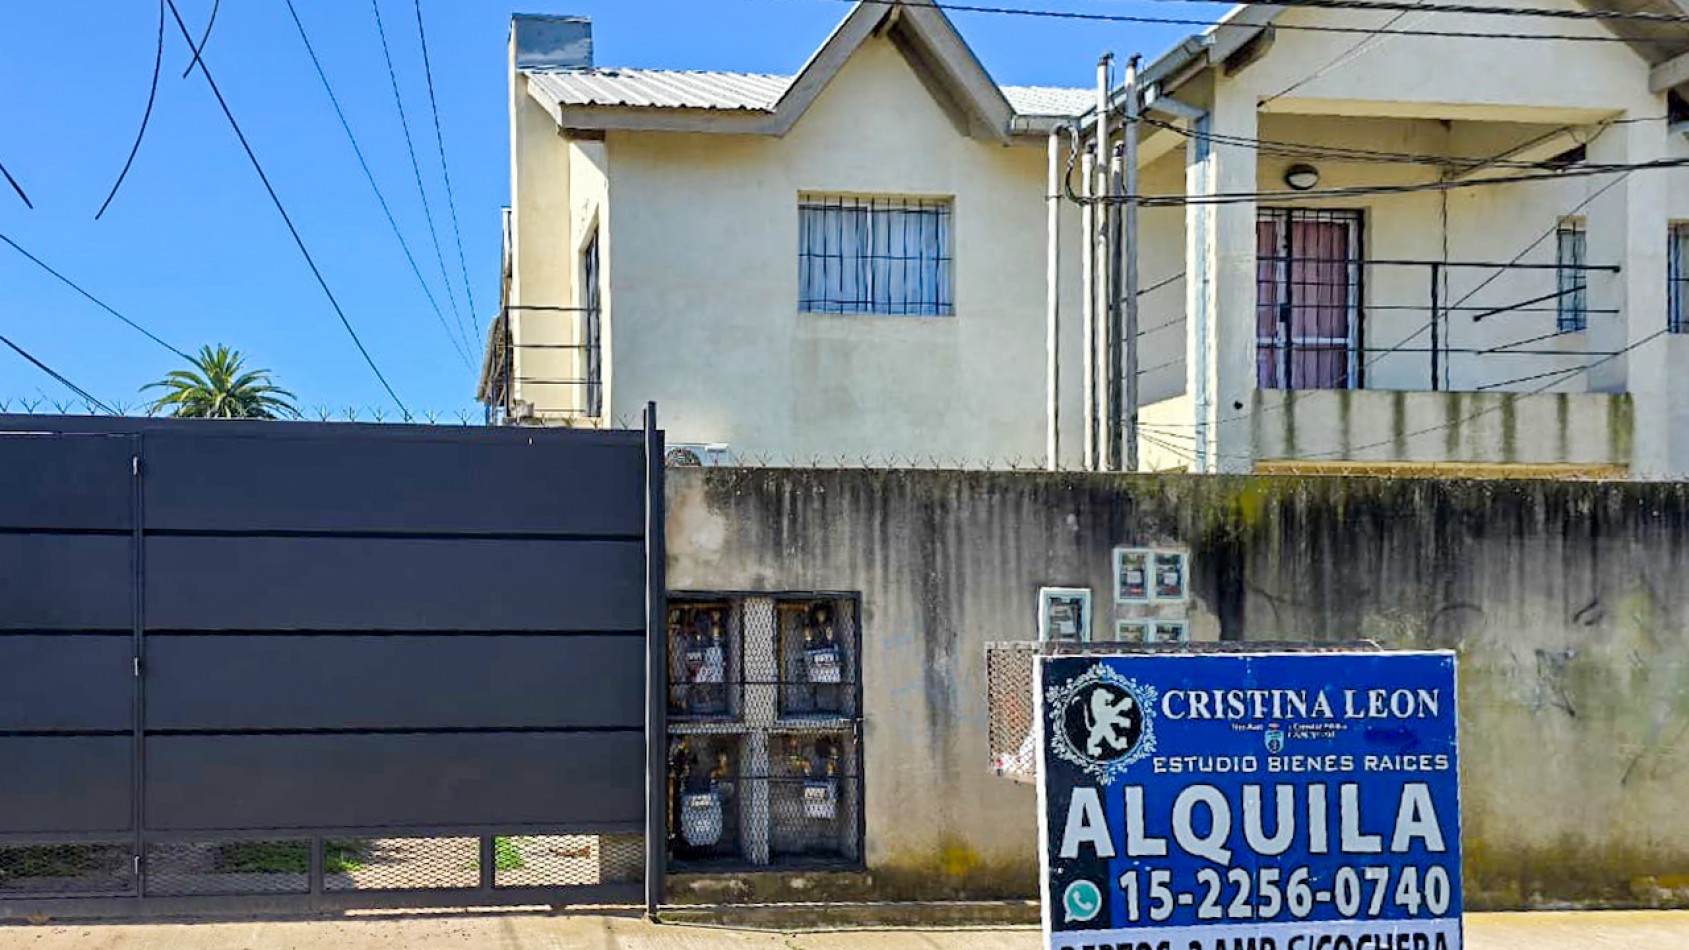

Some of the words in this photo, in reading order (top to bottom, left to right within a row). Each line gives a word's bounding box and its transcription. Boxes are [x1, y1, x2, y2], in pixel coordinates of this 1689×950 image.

[1161, 689, 1334, 720] CRISTINA
[1344, 688, 1440, 719] LEON
[1153, 756, 1258, 774] ESTUDIO
[1268, 755, 1355, 772] BIENES
[1364, 754, 1450, 771] RAICES
[1060, 783, 1447, 866] ALQUILA
[1119, 866, 1451, 922] 15-2256-0740
